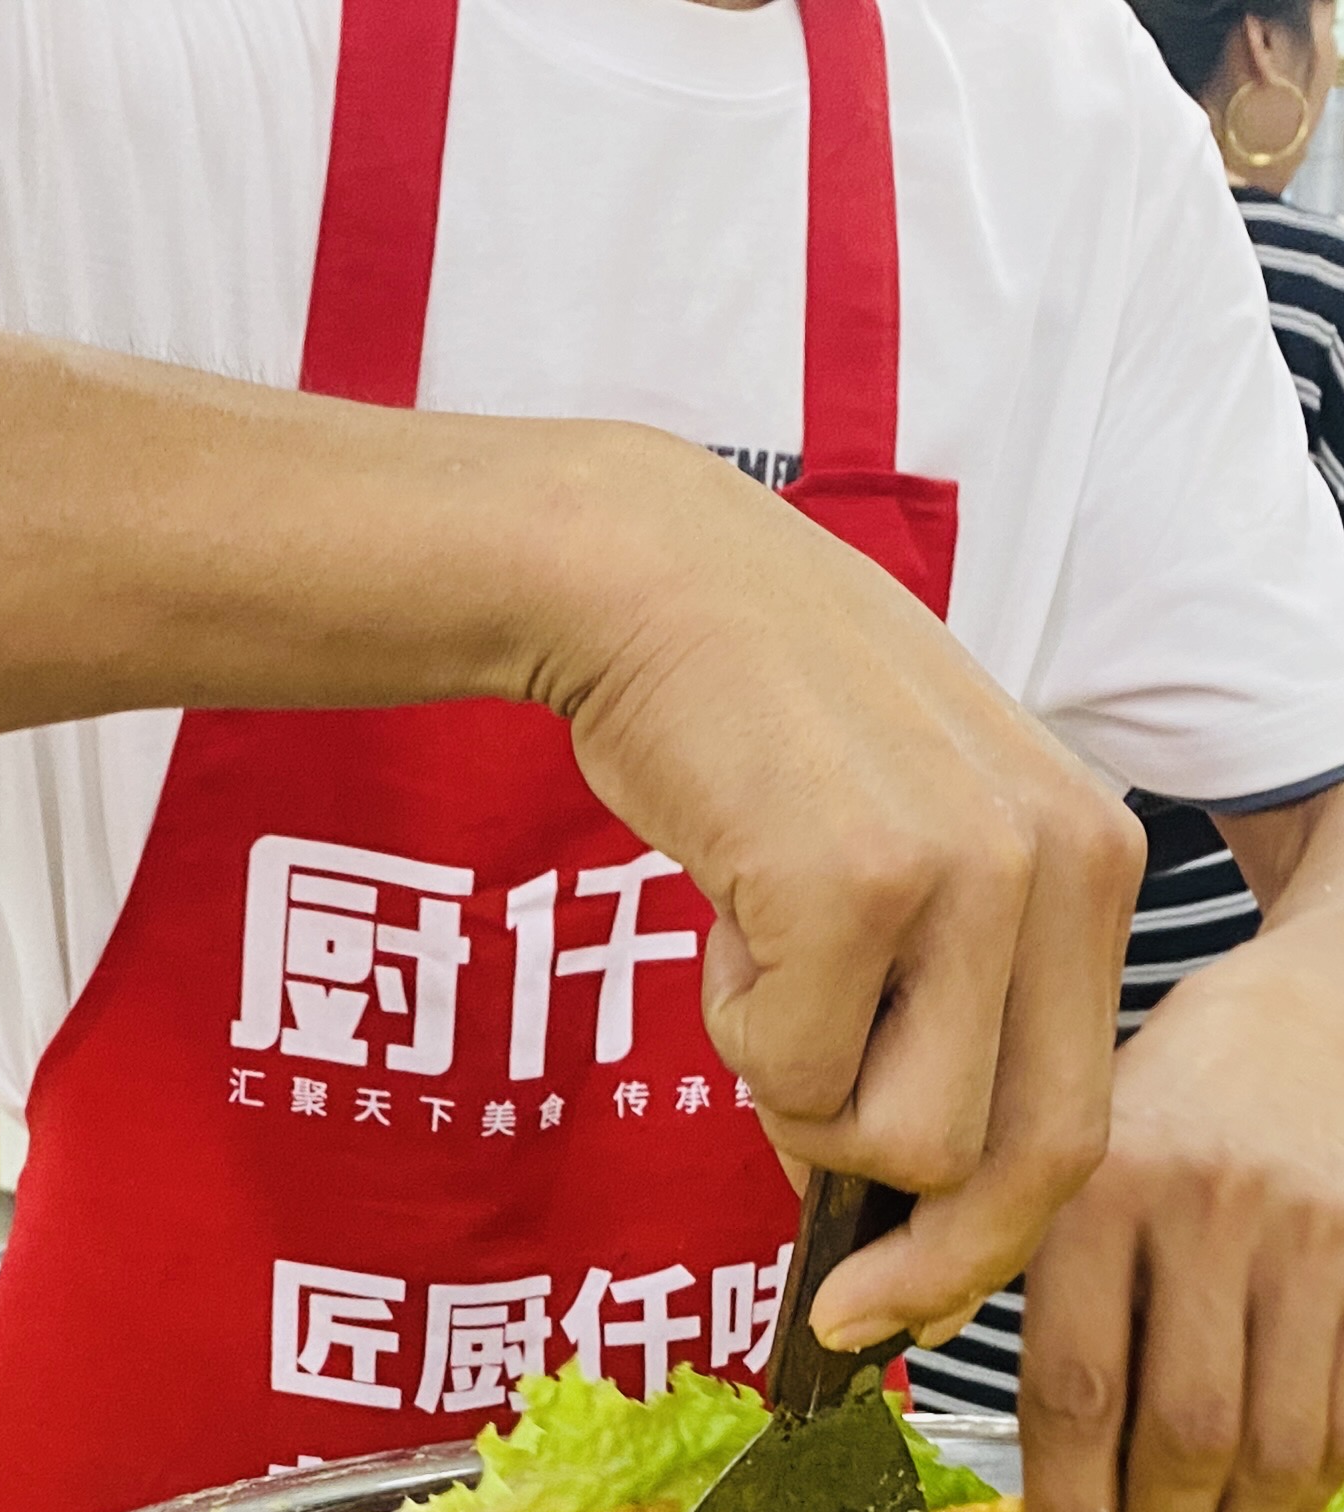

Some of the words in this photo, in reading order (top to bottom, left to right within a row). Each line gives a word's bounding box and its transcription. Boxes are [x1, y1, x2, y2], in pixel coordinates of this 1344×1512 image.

[230, 834, 698, 1080] 厨仟
[228, 1067, 565, 1137] 汇聚天下美食
